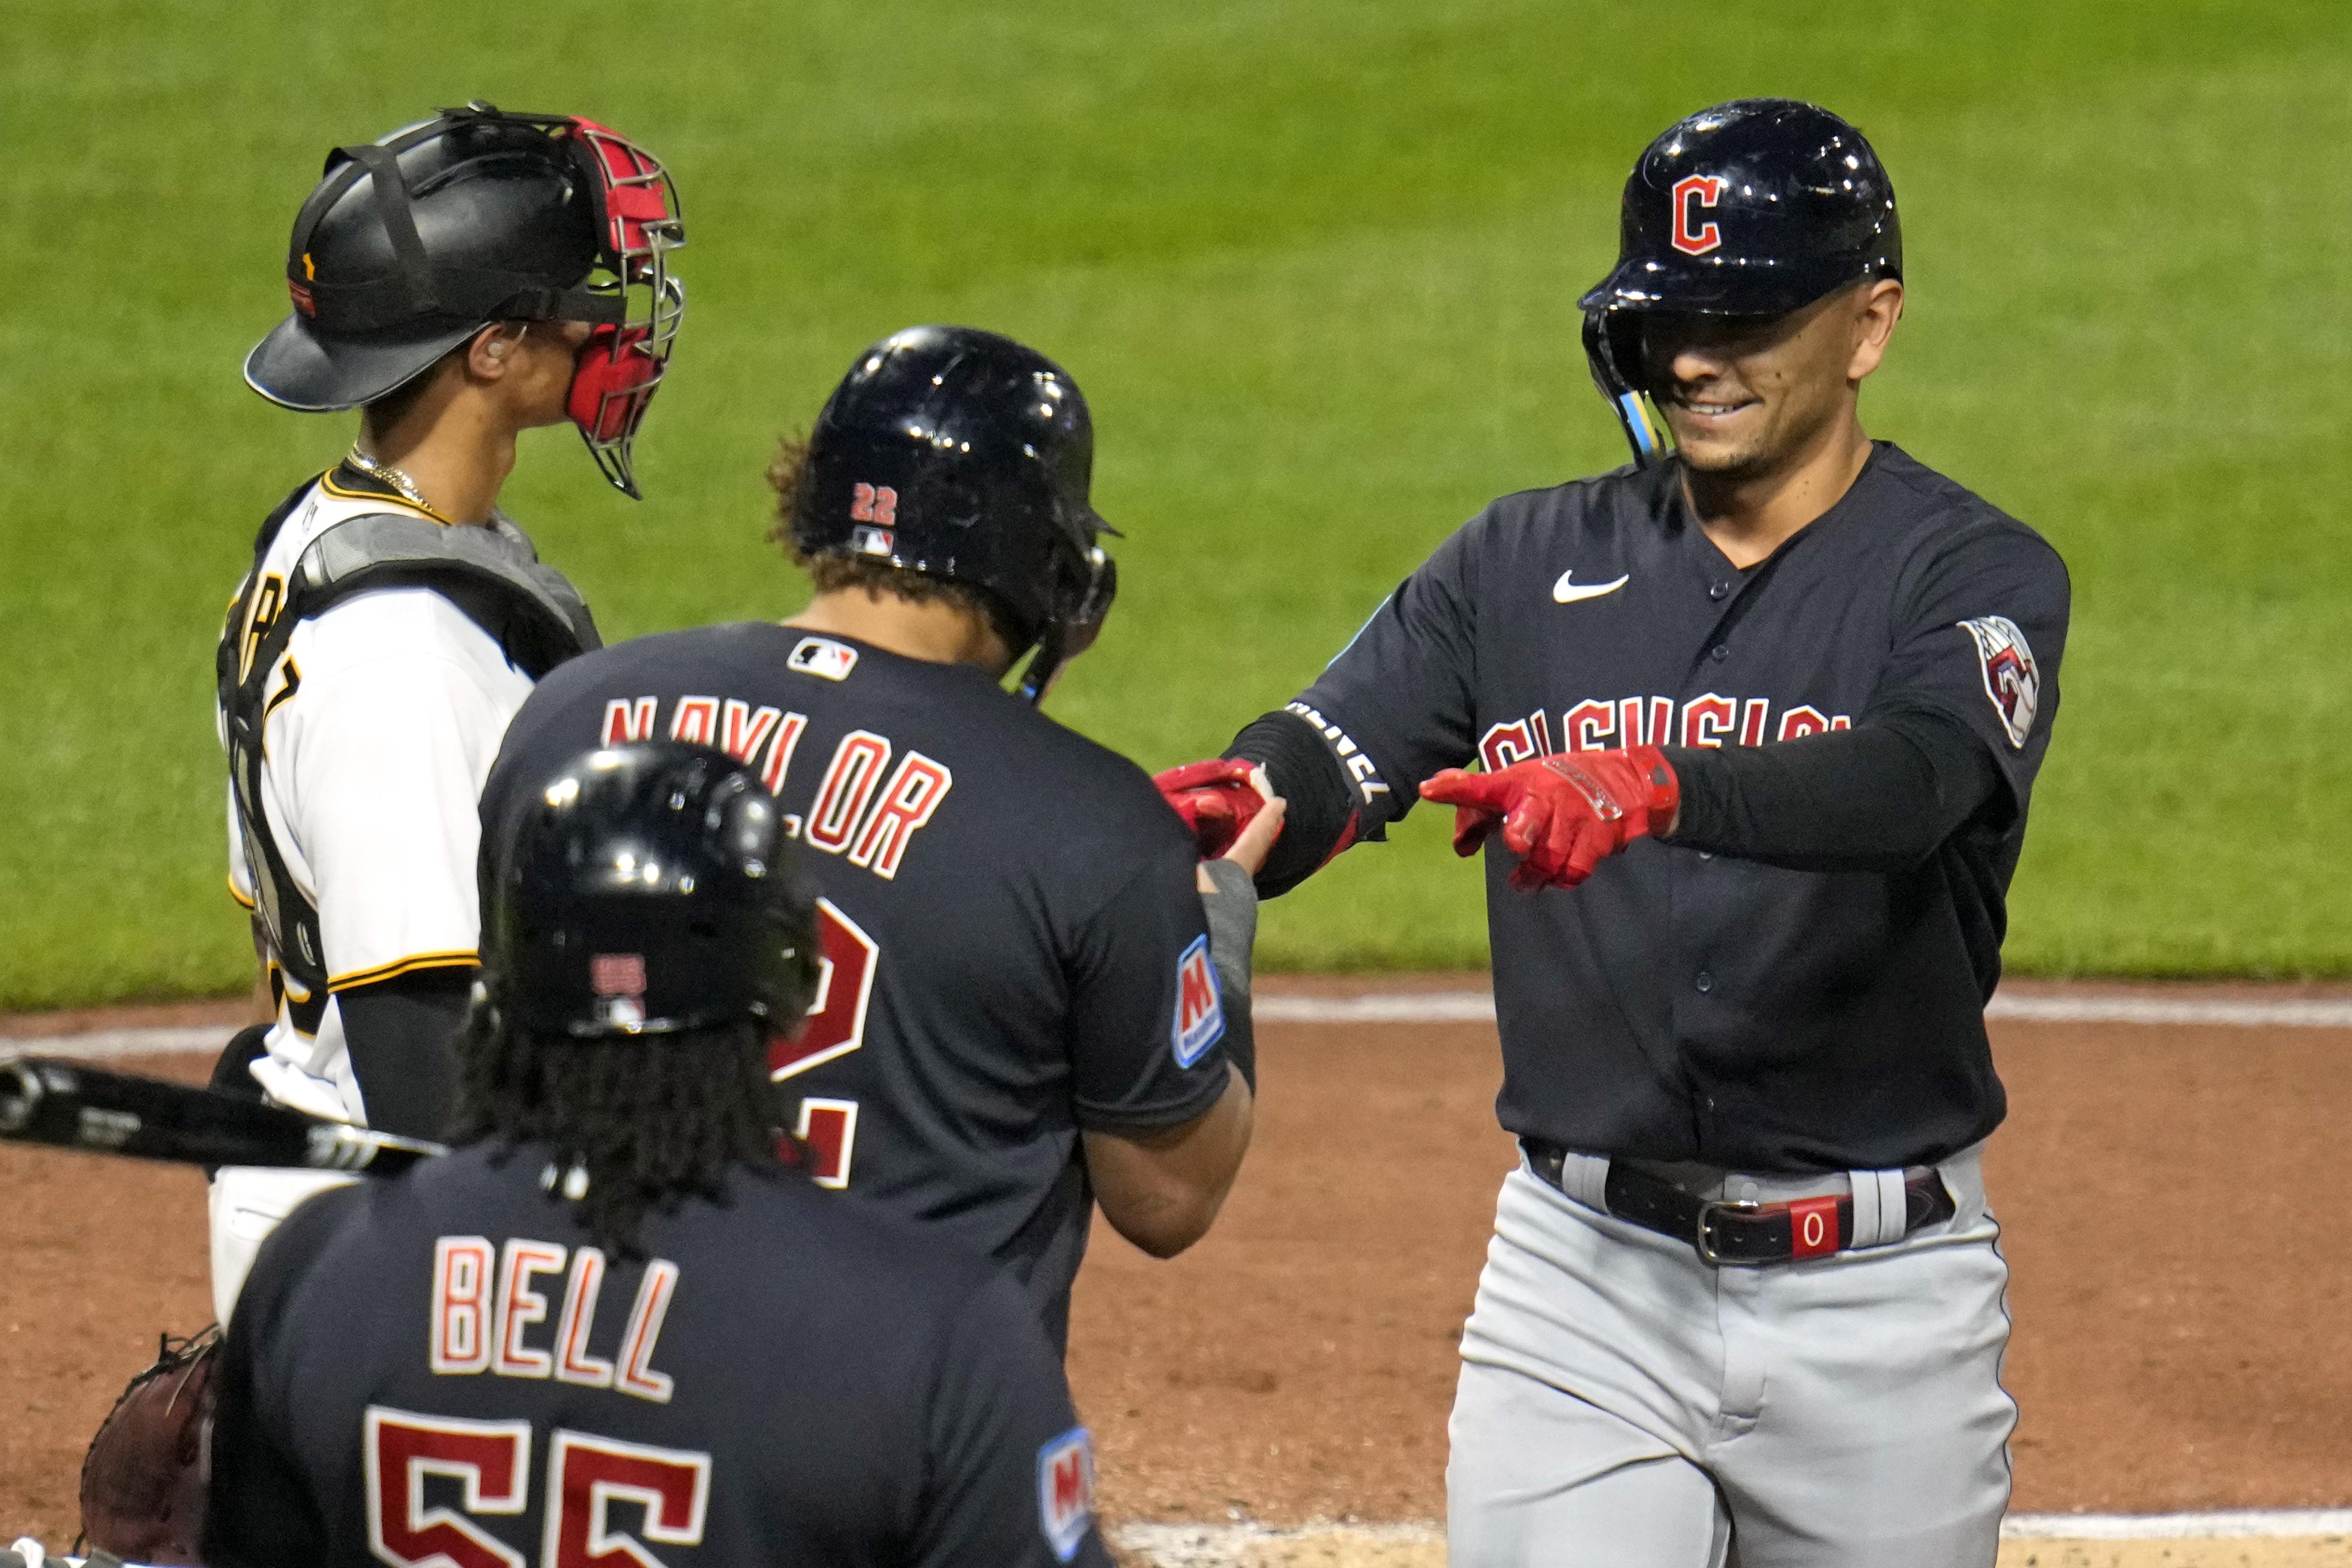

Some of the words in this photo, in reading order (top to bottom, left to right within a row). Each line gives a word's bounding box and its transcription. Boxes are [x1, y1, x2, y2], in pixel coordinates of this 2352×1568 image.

[1671, 173, 1722, 256] C
[850, 481, 898, 526] 22
[1803, 1211, 1824, 1247] 0
[430, 1235, 680, 1404] BELL
